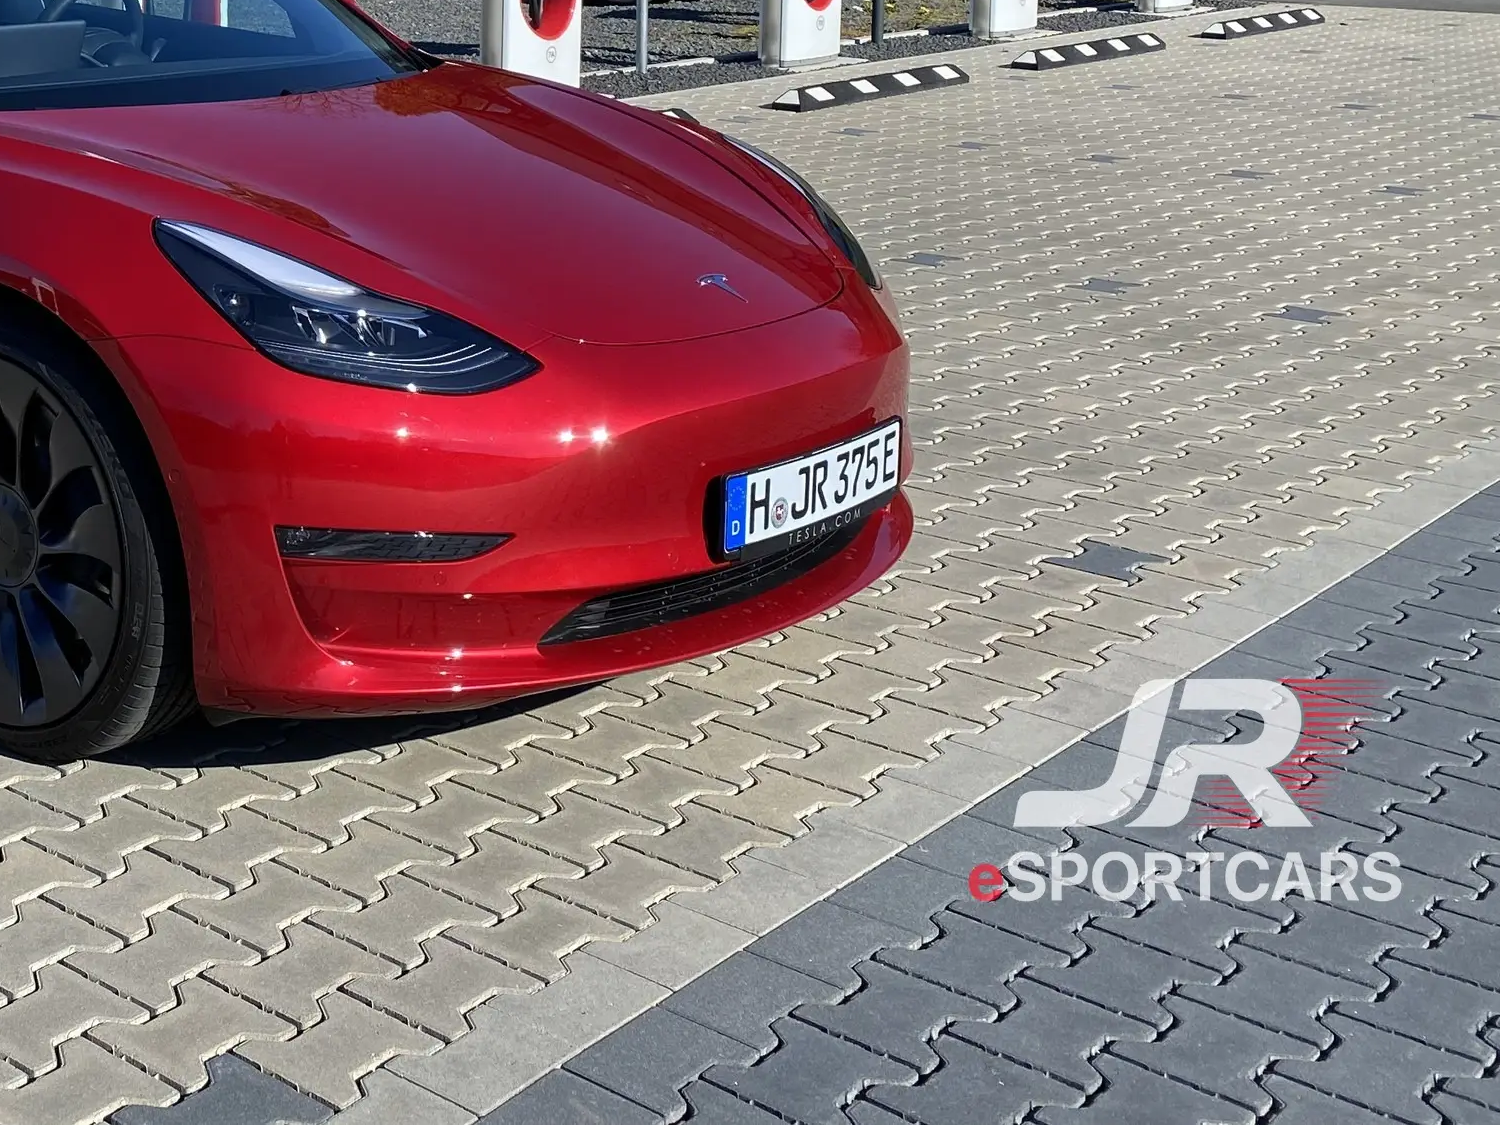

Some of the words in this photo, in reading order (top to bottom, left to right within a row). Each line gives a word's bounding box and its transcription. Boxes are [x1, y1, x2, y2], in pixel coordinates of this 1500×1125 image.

[731, 520, 740, 536] D
[749, 478, 771, 535] H
[788, 508, 861, 545] TESLA.COM
